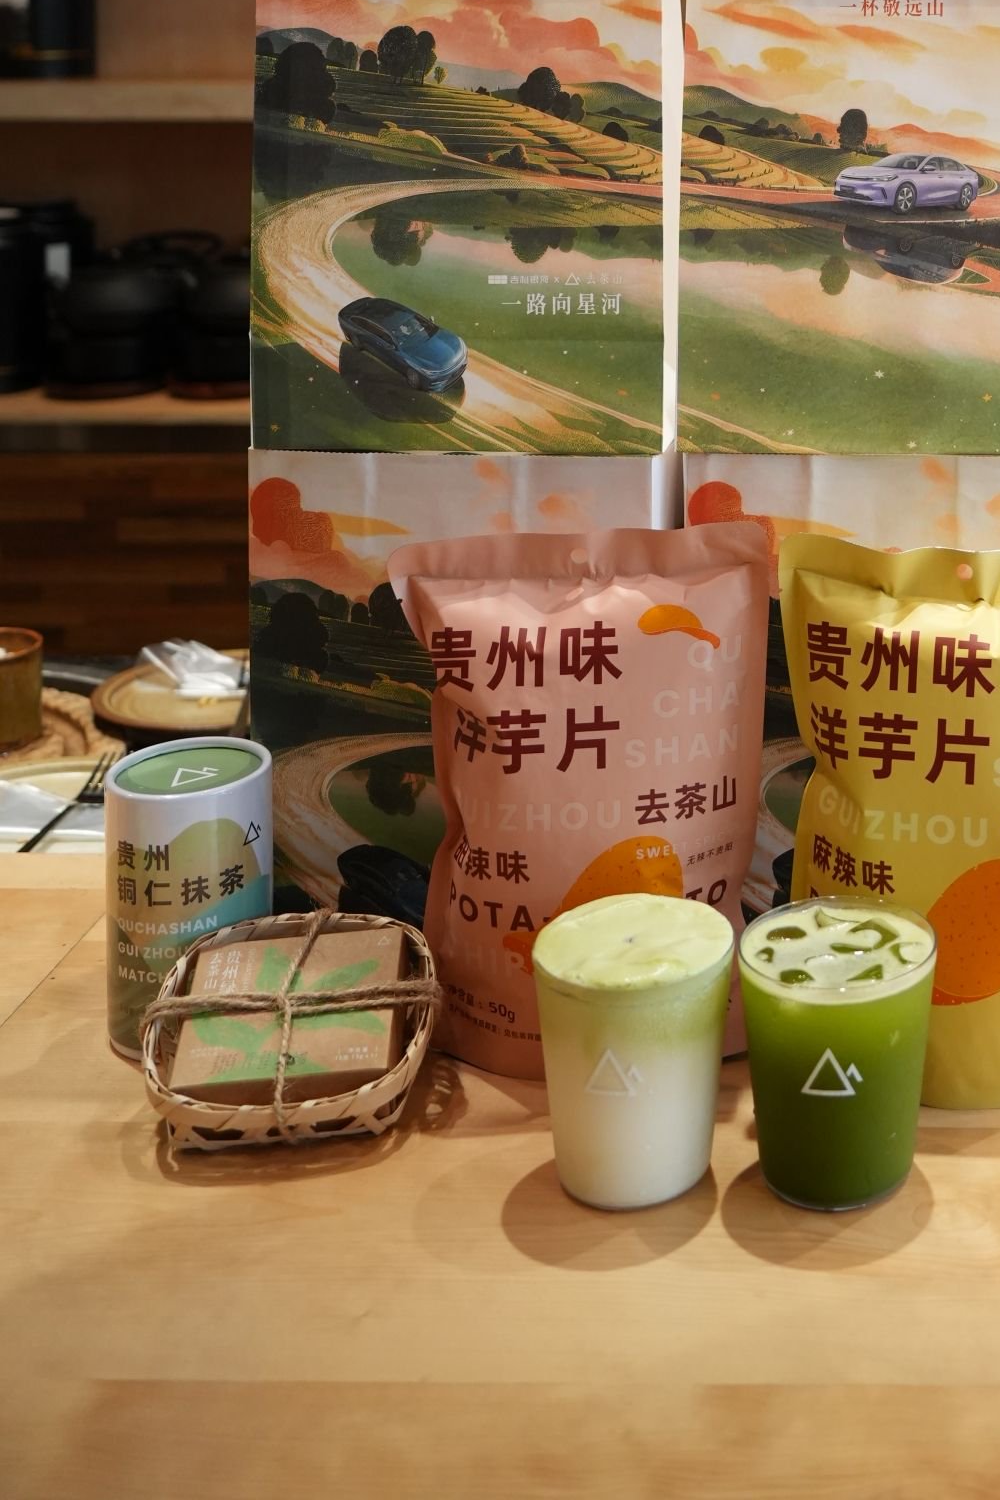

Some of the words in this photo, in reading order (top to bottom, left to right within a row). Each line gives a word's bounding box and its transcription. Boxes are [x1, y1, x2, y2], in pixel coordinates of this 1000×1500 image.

[501, 293, 622, 315] 一路向星河
[431, 620, 623, 693] 贵州味
[687, 634, 743, 673] QU
[807, 620, 996, 698] 贵州味
[652, 680, 740, 719] CHA
[454, 705, 620, 775] 洋芋片
[624, 723, 739, 770] SHAN
[810, 702, 990, 786] 洋芋片
[462, 798, 622, 832] UIZHOU
[634, 774, 738, 827] 去茶山
[818, 784, 989, 848] GUIZHOU
[116, 840, 170, 872] 贵州
[811, 833, 896, 896] 麻辣味
[116, 864, 245, 908] 铜仁抹茶
[117, 914, 218, 936] QUCHASHAN
[118, 964, 169, 985] MATCH
